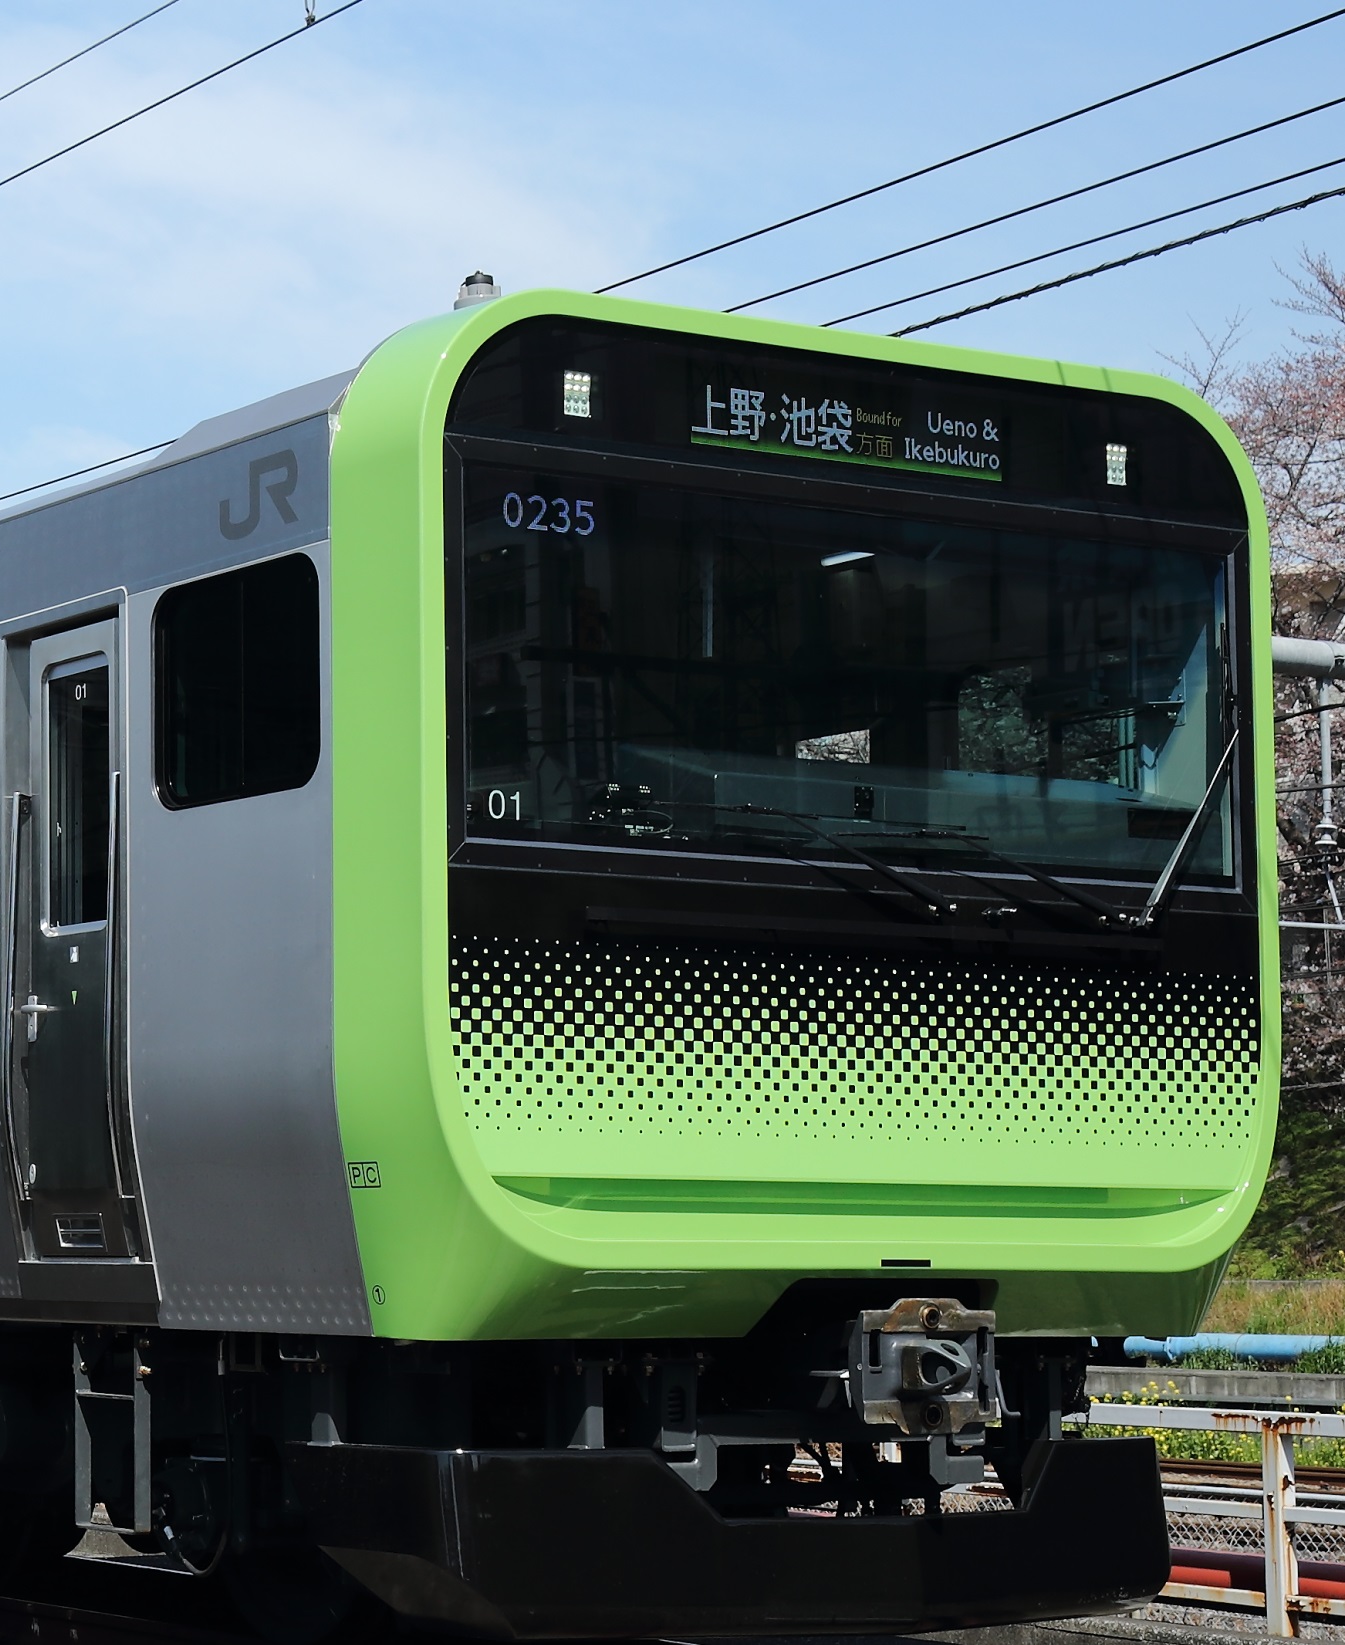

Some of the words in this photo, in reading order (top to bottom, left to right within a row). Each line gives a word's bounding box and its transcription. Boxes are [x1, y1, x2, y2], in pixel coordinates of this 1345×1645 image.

[856, 408, 885, 425] Bound
[887, 411, 903, 427] for
[927, 411, 978, 438] Ueno
[983, 419, 1000, 442] &
[856, 432, 894, 458] 方面
[904, 437, 1001, 470] Ikebukuro
[219, 449, 300, 541] JR
[502, 492, 595, 536] 0235
[75, 683, 87, 700] 01
[488, 789, 520, 821] 01
